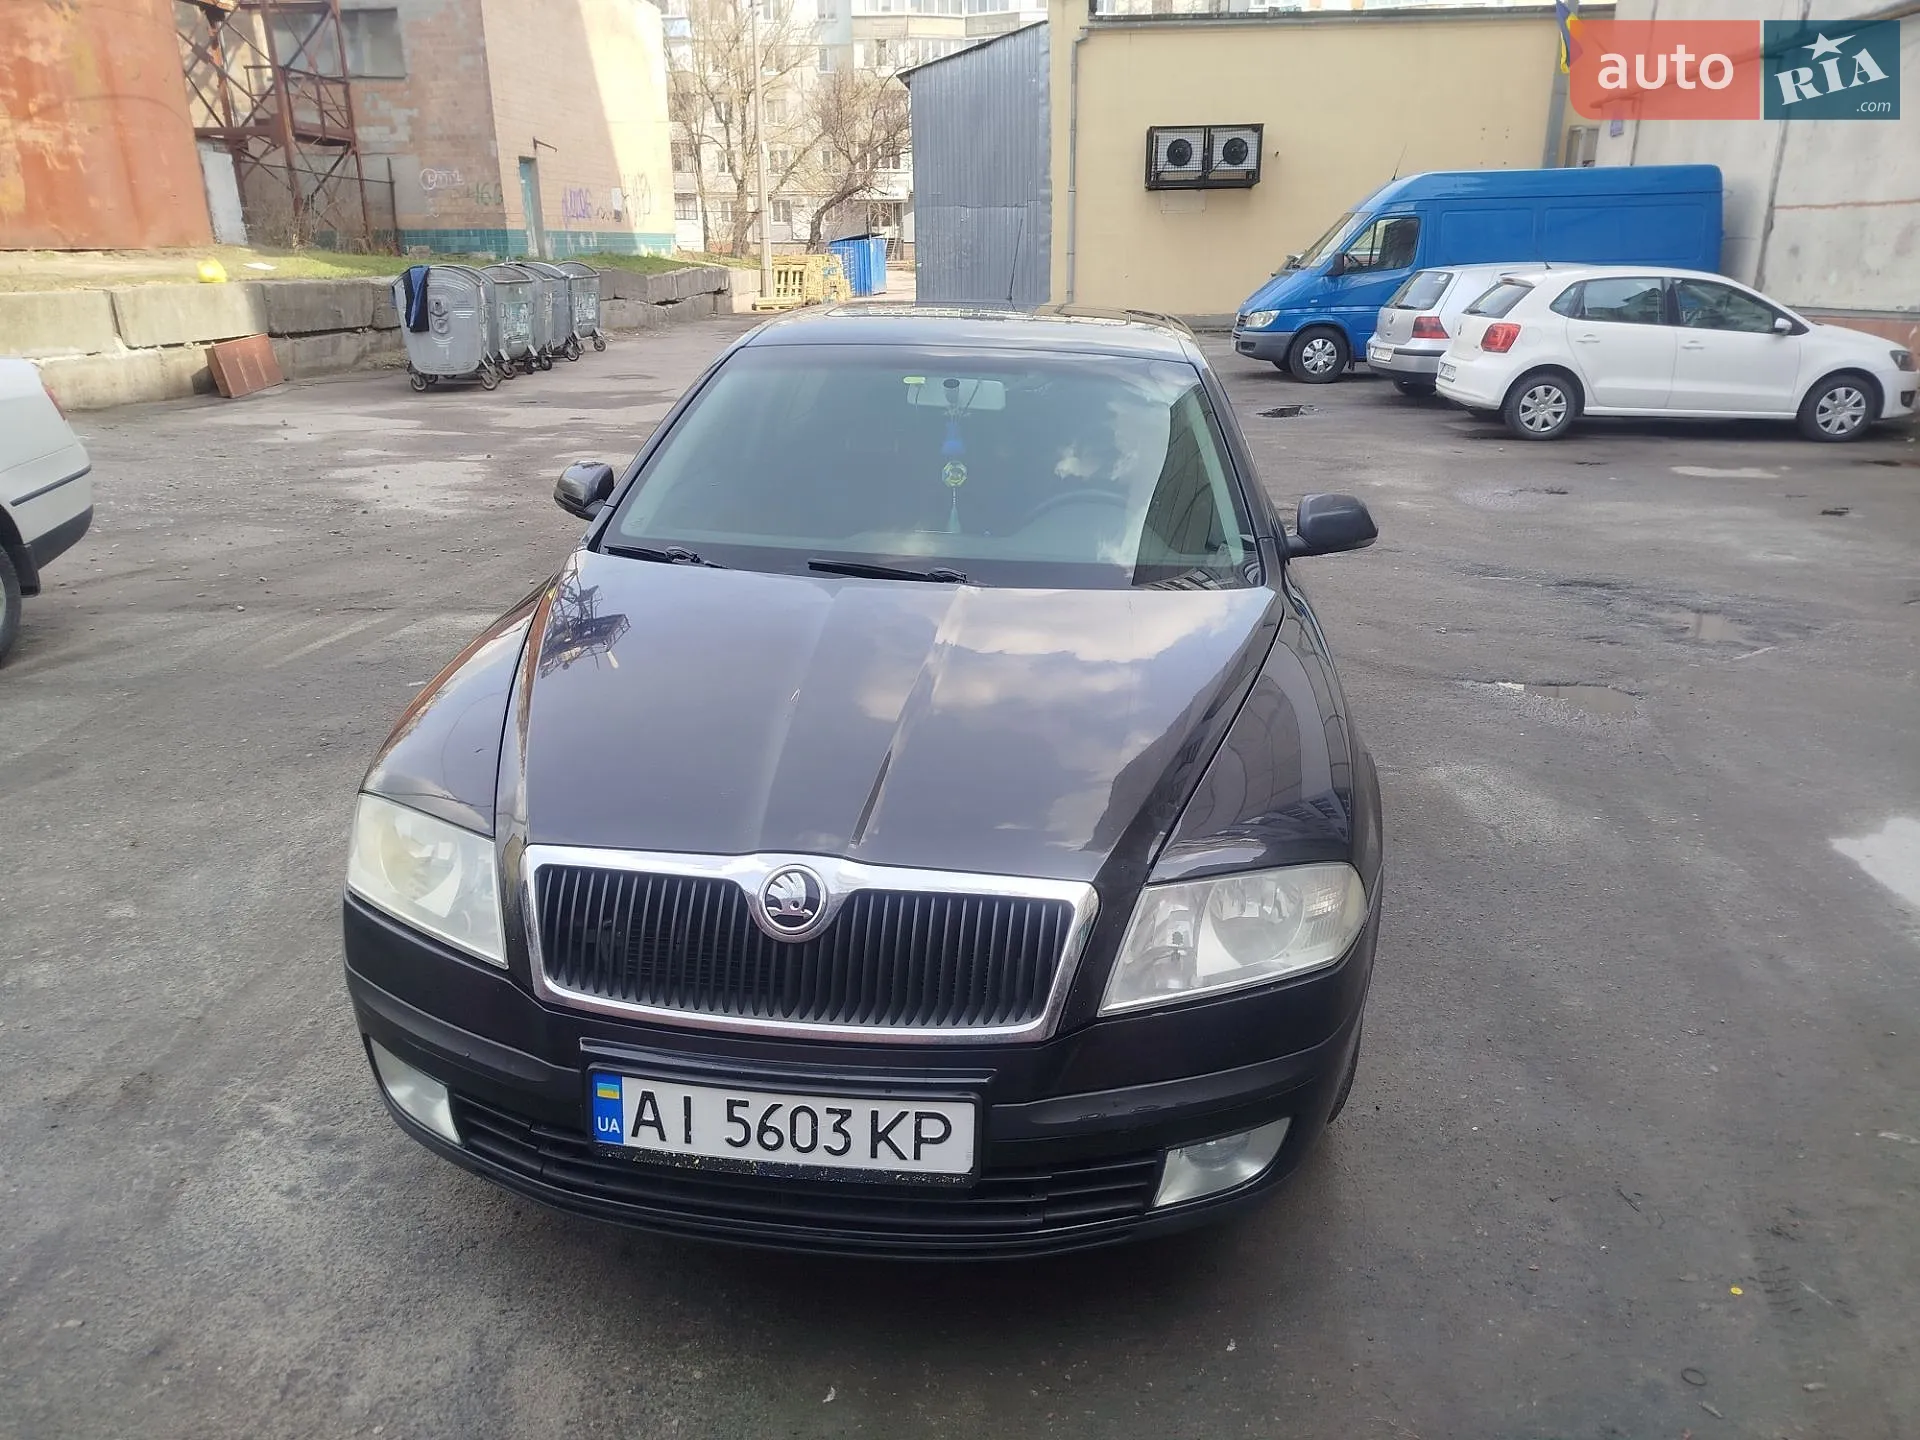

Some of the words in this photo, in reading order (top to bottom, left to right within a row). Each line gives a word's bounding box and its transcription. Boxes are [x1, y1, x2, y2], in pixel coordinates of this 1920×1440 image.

[597, 1116, 621, 1134] UA
[631, 1090, 692, 1144] AI
[724, 1098, 853, 1157] 5603
[869, 1110, 953, 1161] KP
